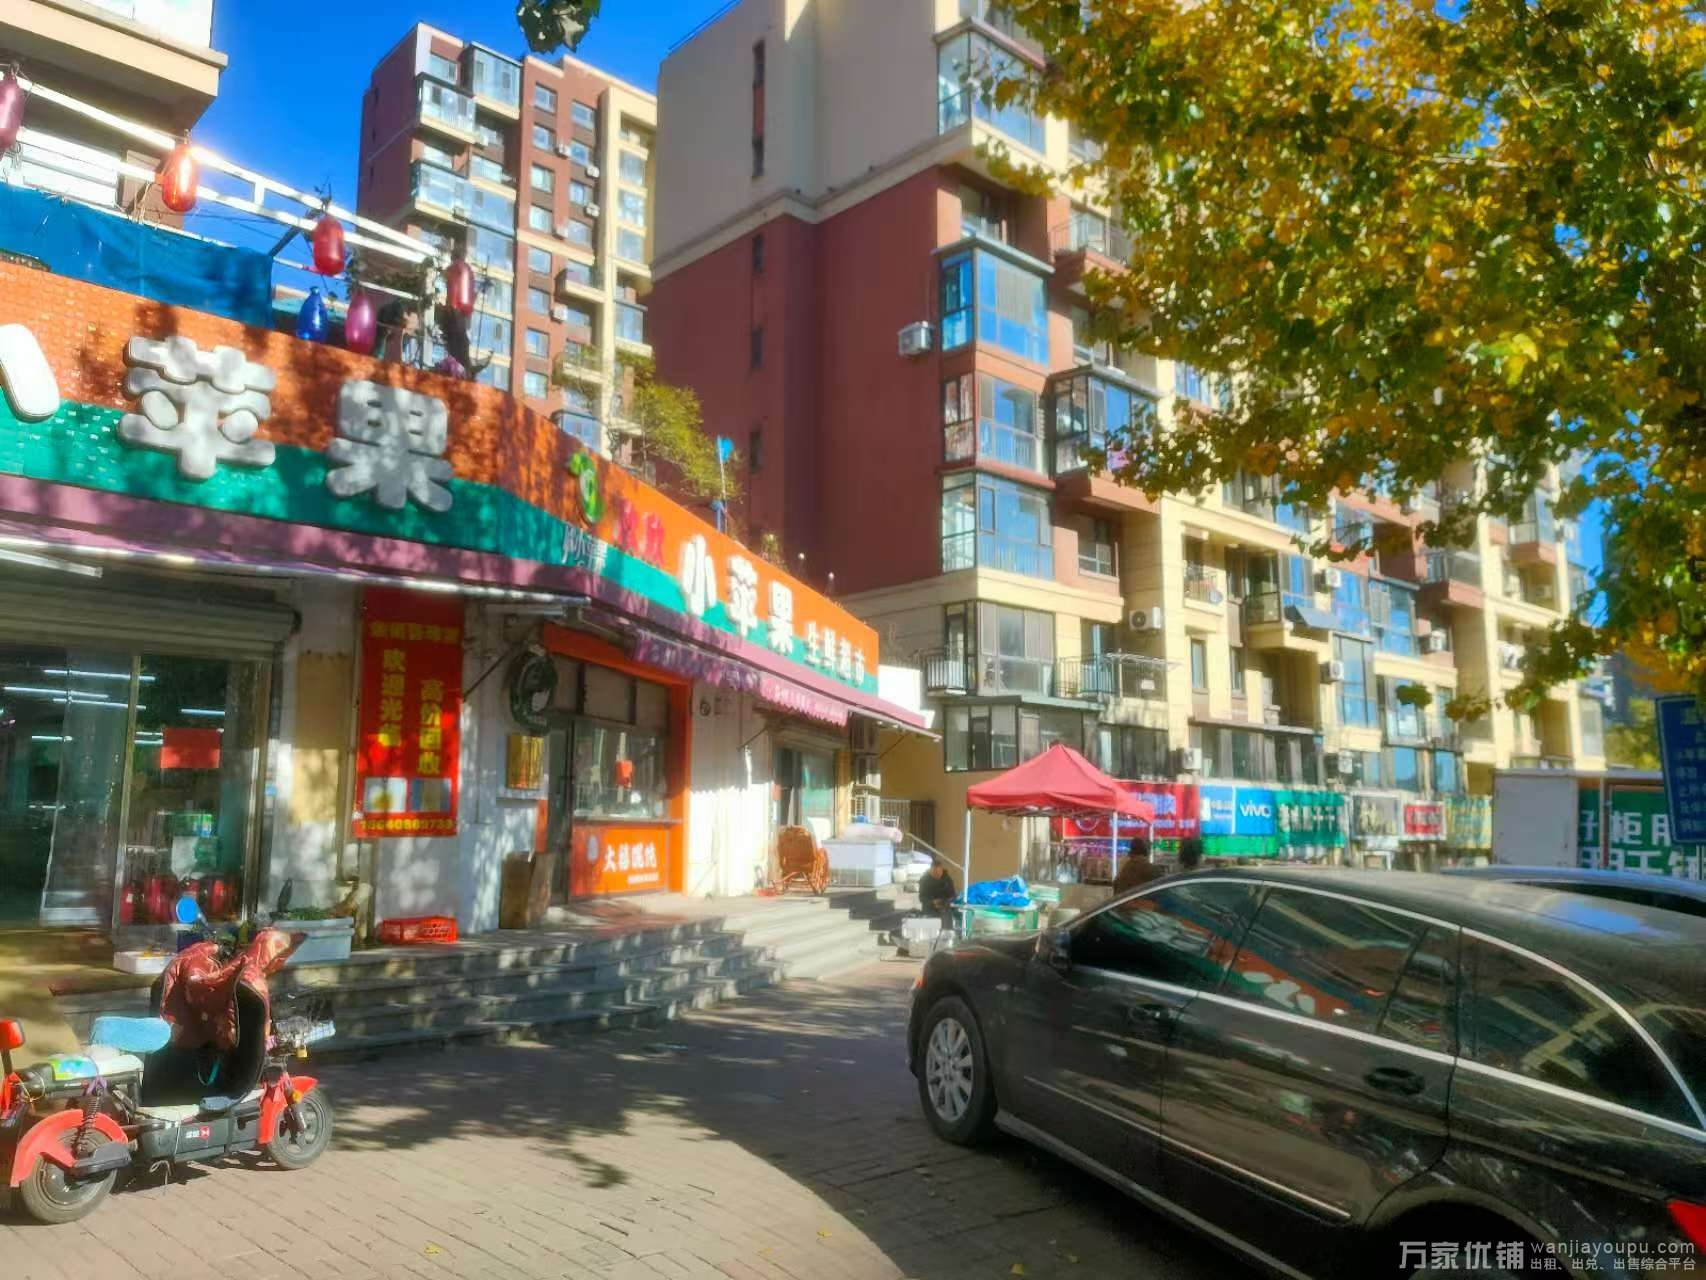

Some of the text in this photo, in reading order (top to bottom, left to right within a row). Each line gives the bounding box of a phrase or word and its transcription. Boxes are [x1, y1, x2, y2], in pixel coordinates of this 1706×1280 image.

[680, 533, 795, 657] 小苹果
[804, 621, 866, 686] 生鲜超市
[418, 679, 443, 775] 高价回收
[1239, 800, 1272, 818] vivo
